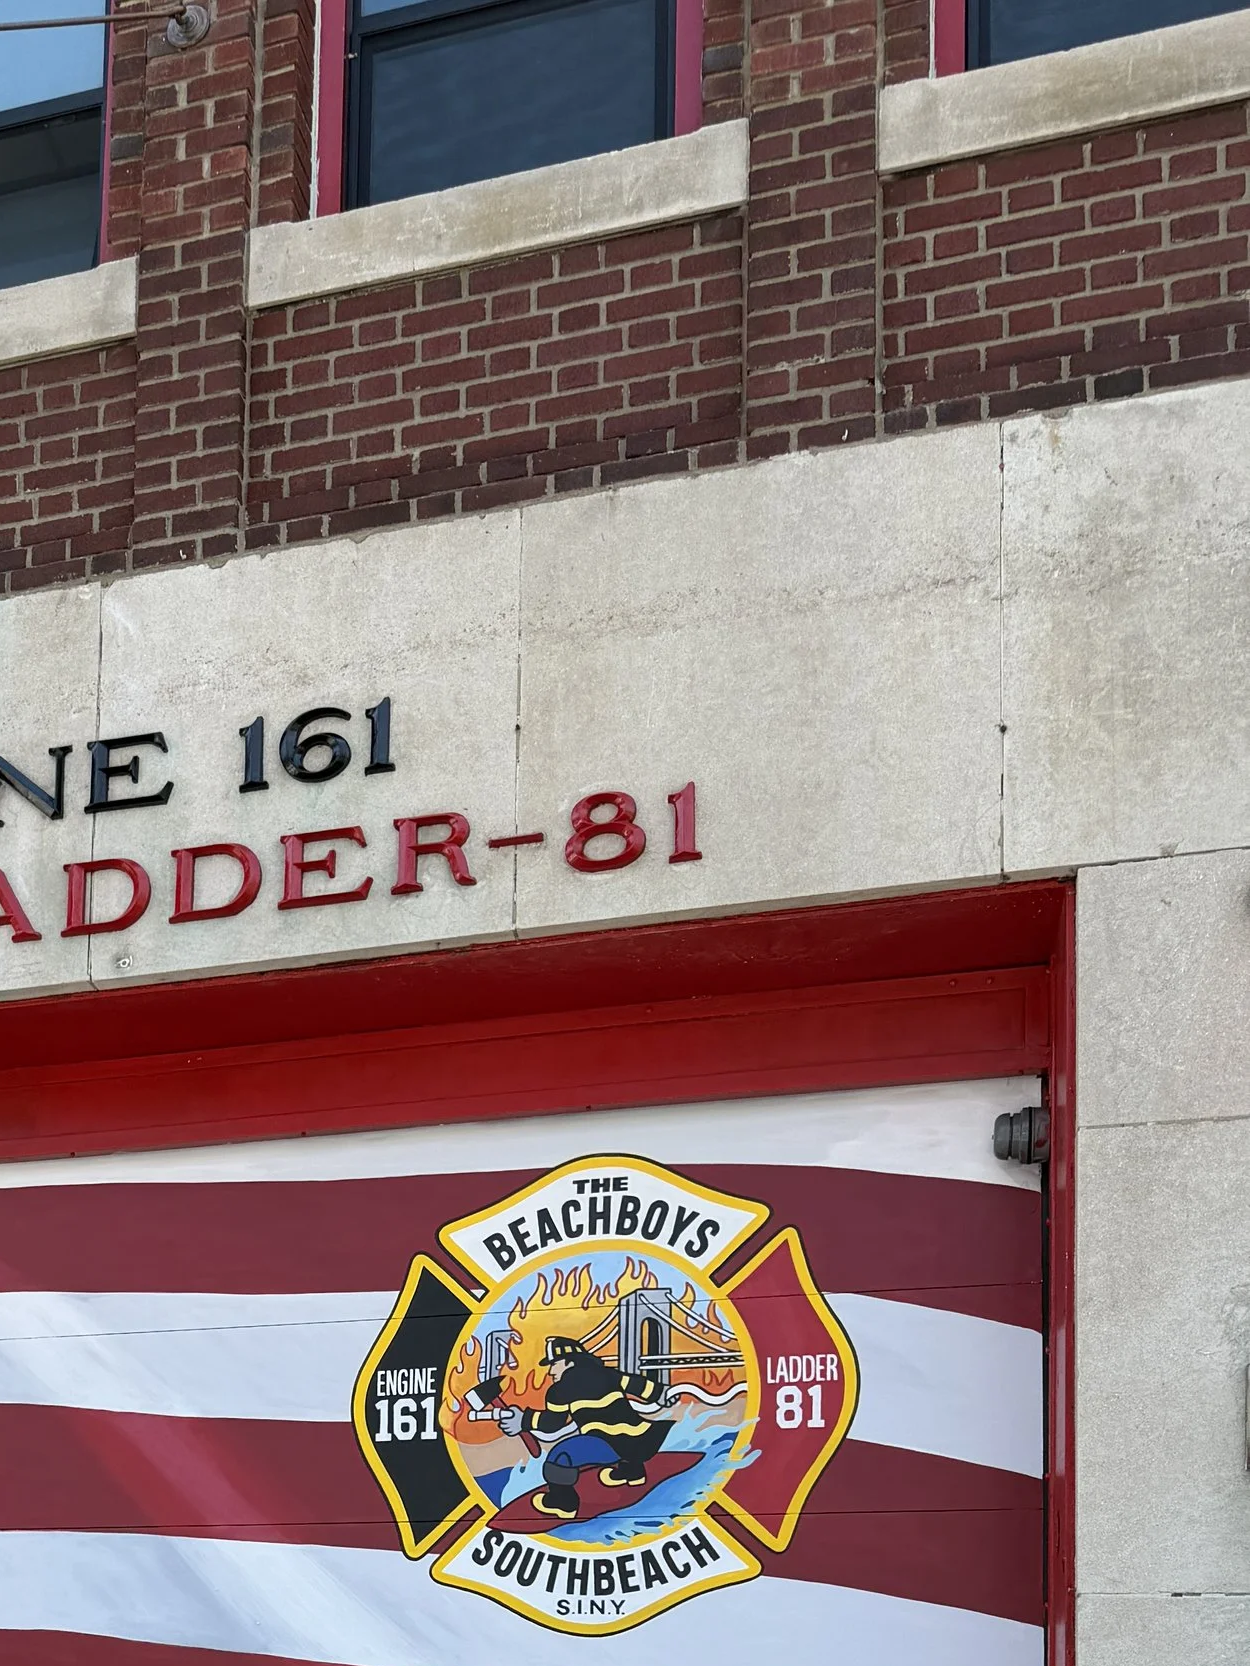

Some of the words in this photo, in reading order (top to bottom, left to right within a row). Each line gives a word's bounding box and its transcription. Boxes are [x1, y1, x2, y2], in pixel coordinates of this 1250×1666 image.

[238, 696, 397, 793] 161
[572, 1176, 629, 1194] THE
[483, 1194, 721, 1271] BEACHBOYS
[376, 1367, 437, 1397] ENGINE
[766, 1353, 839, 1384] LADDER
[374, 1397, 438, 1442] 161
[775, 1385, 826, 1429] 81
[471, 1525, 721, 1597] SOUTHBEACH
